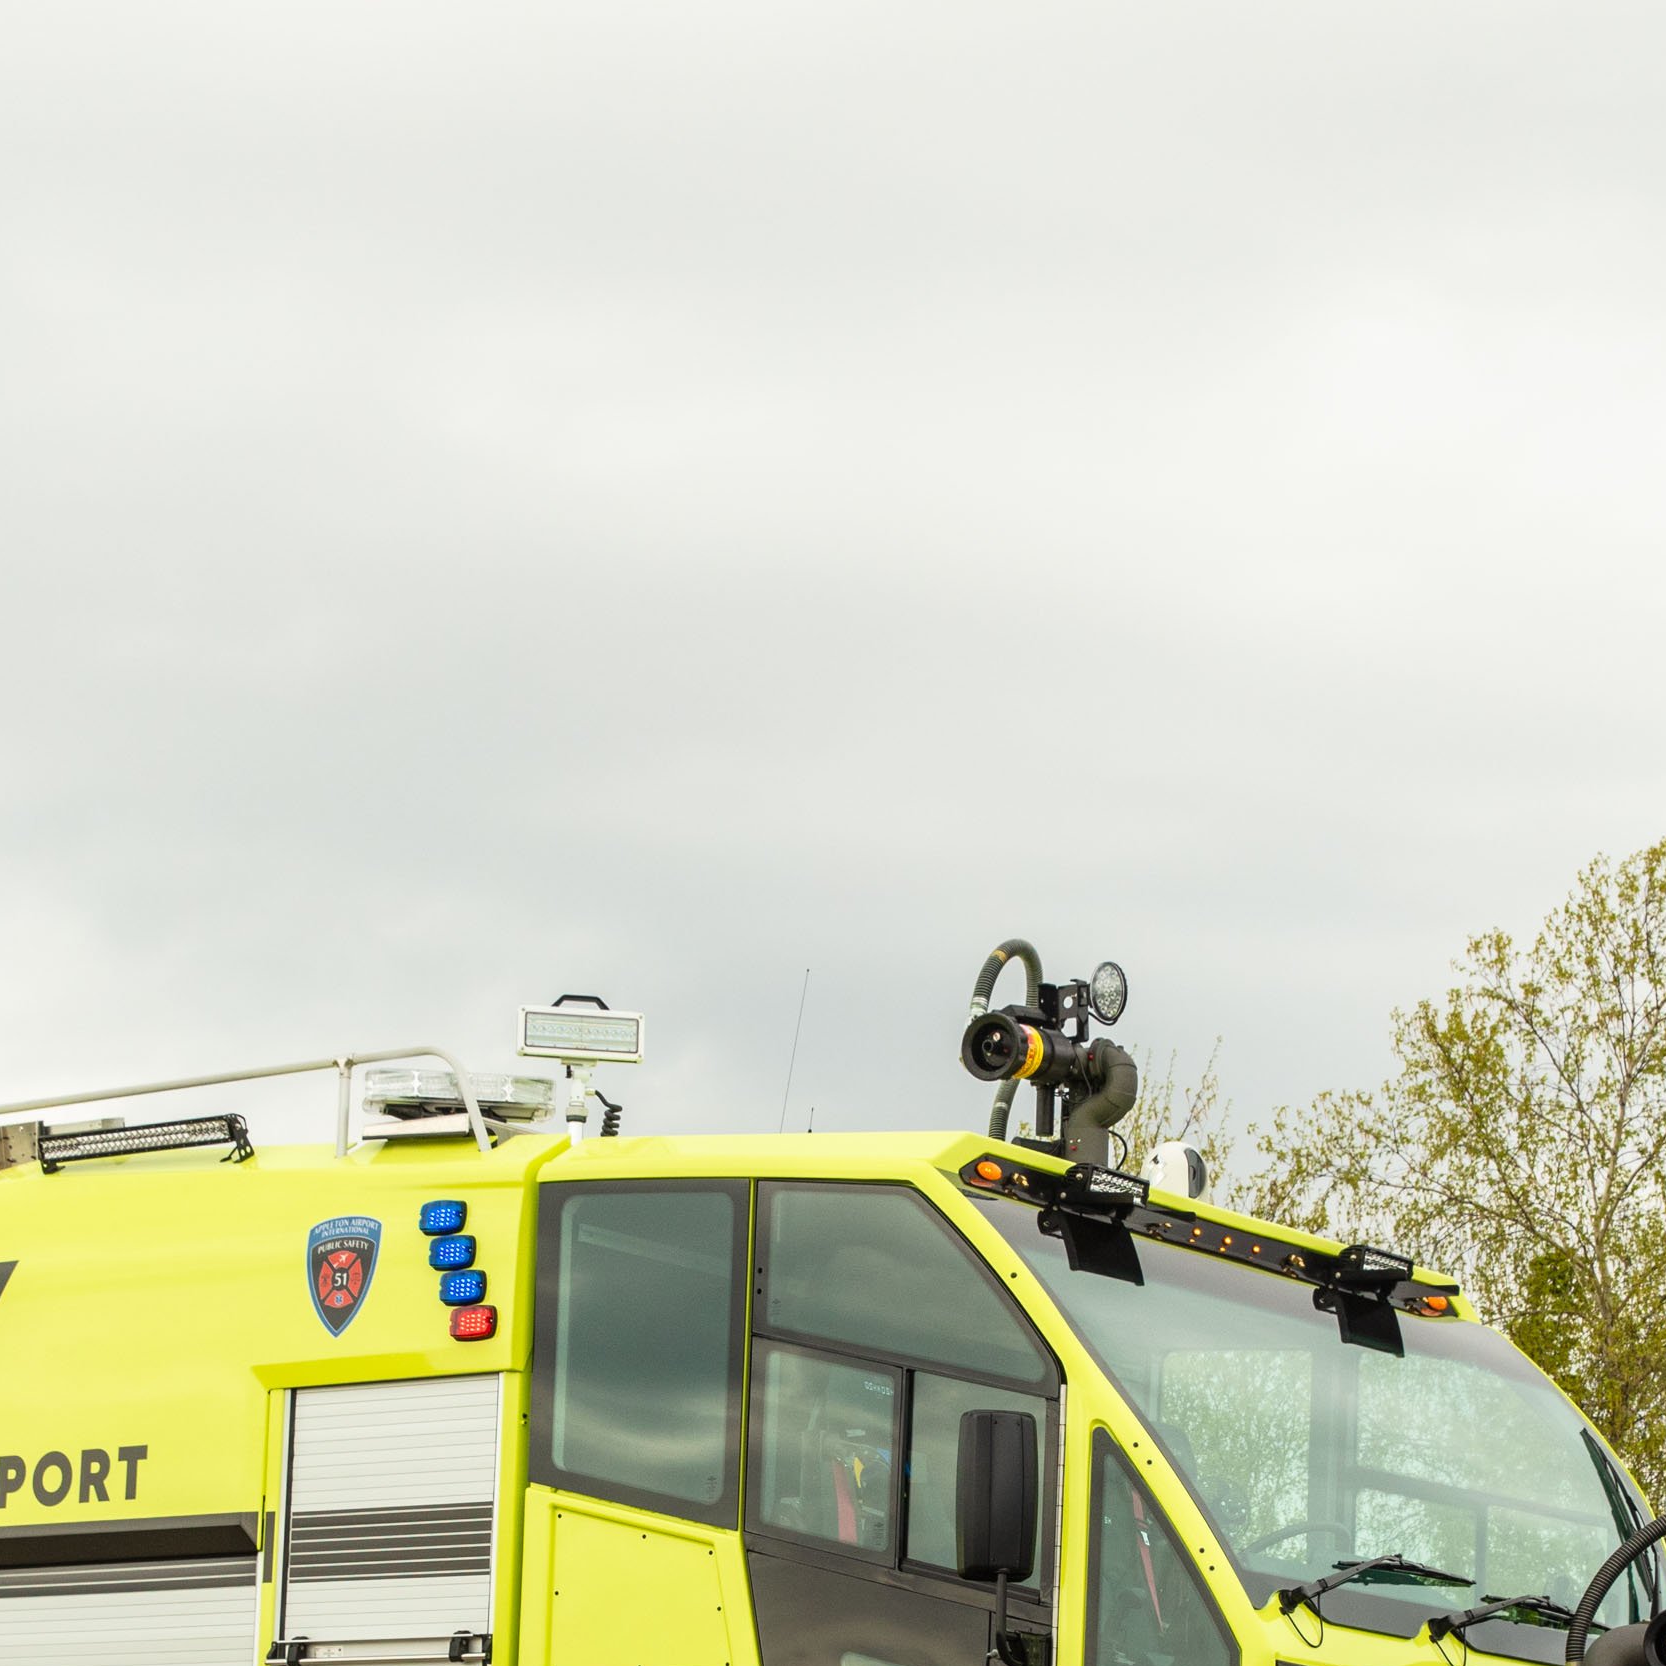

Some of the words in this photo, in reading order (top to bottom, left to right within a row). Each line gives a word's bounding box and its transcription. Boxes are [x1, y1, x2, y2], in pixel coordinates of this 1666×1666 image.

[351, 1218, 379, 1231] AIRPORT
[317, 1240, 342, 1254] PUBLIC
[343, 1239, 369, 1250] SAFETY
[333, 1273, 347, 1287] 51
